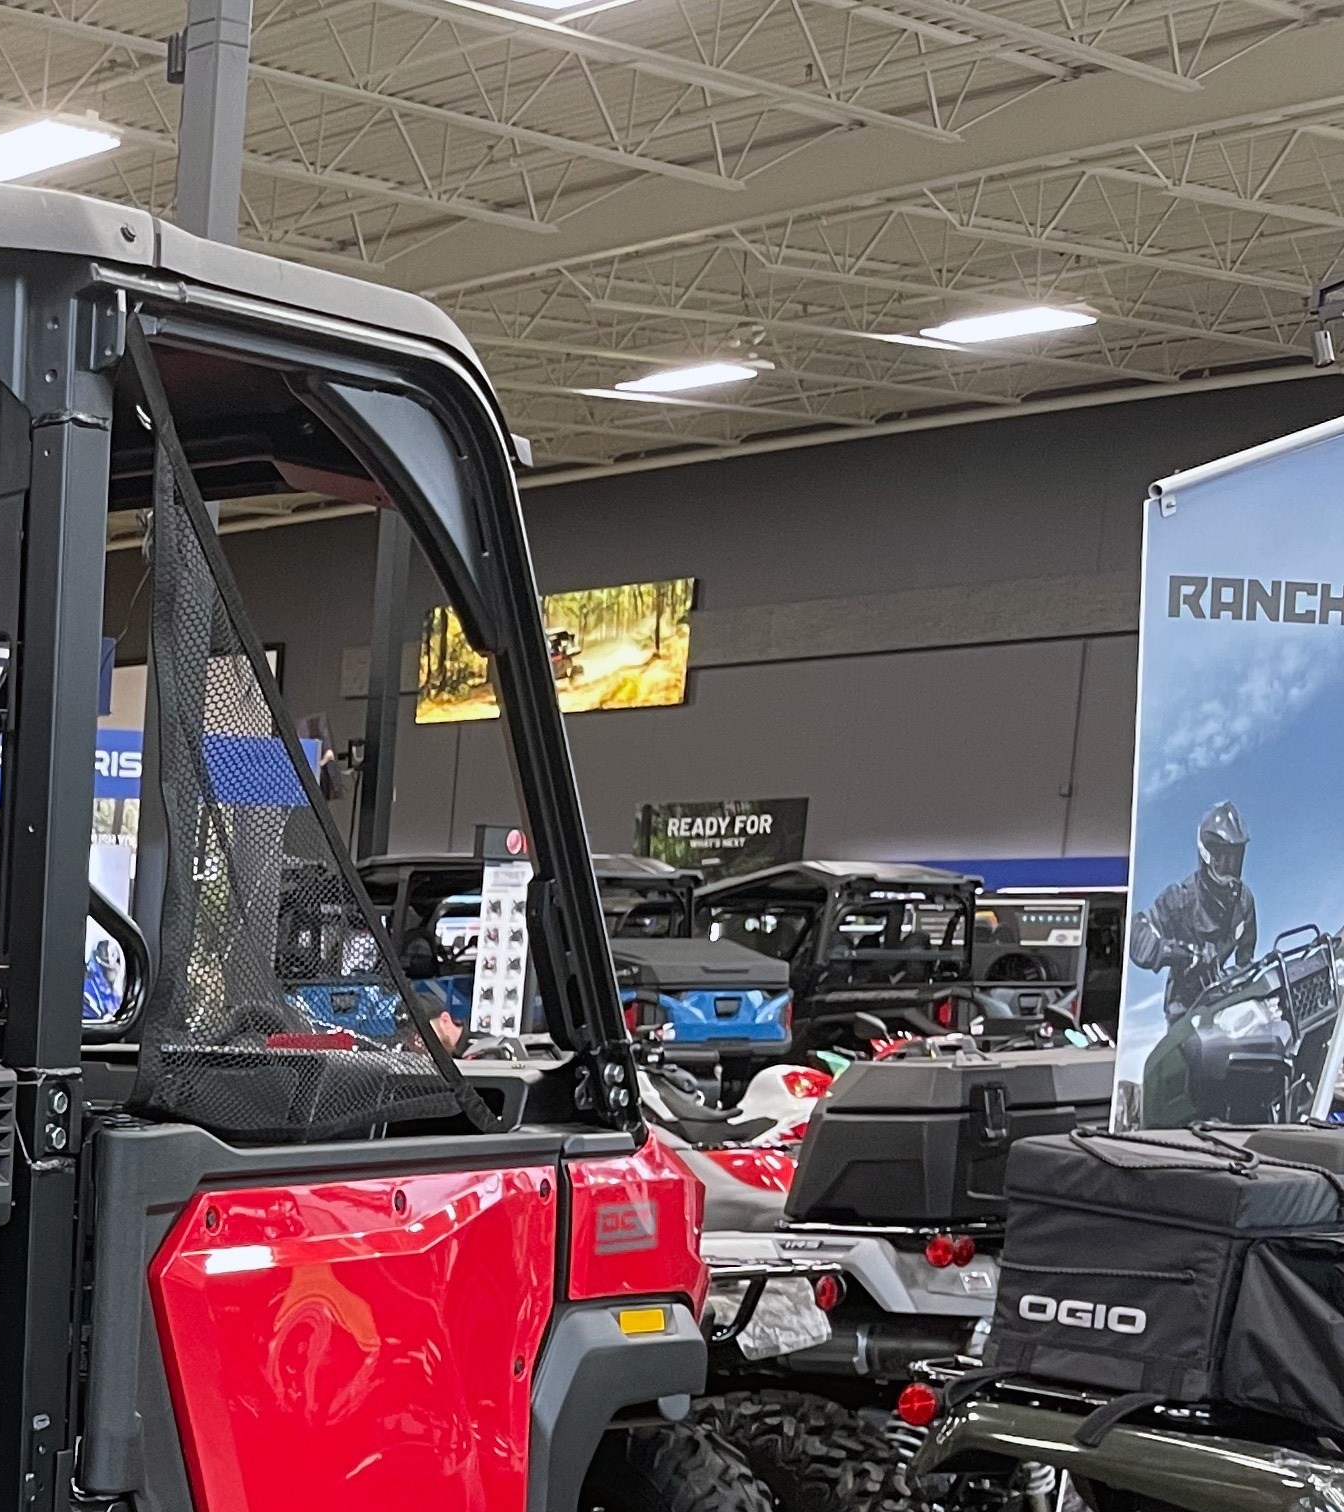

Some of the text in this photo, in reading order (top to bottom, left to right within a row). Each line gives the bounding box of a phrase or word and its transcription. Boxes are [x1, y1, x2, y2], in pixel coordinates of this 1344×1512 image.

[1167, 575, 1344, 626] RANCH
[667, 813, 773, 837] READY FOR
[722, 837, 746, 848] NEXT
[1018, 1294, 1147, 1335] OGIO
